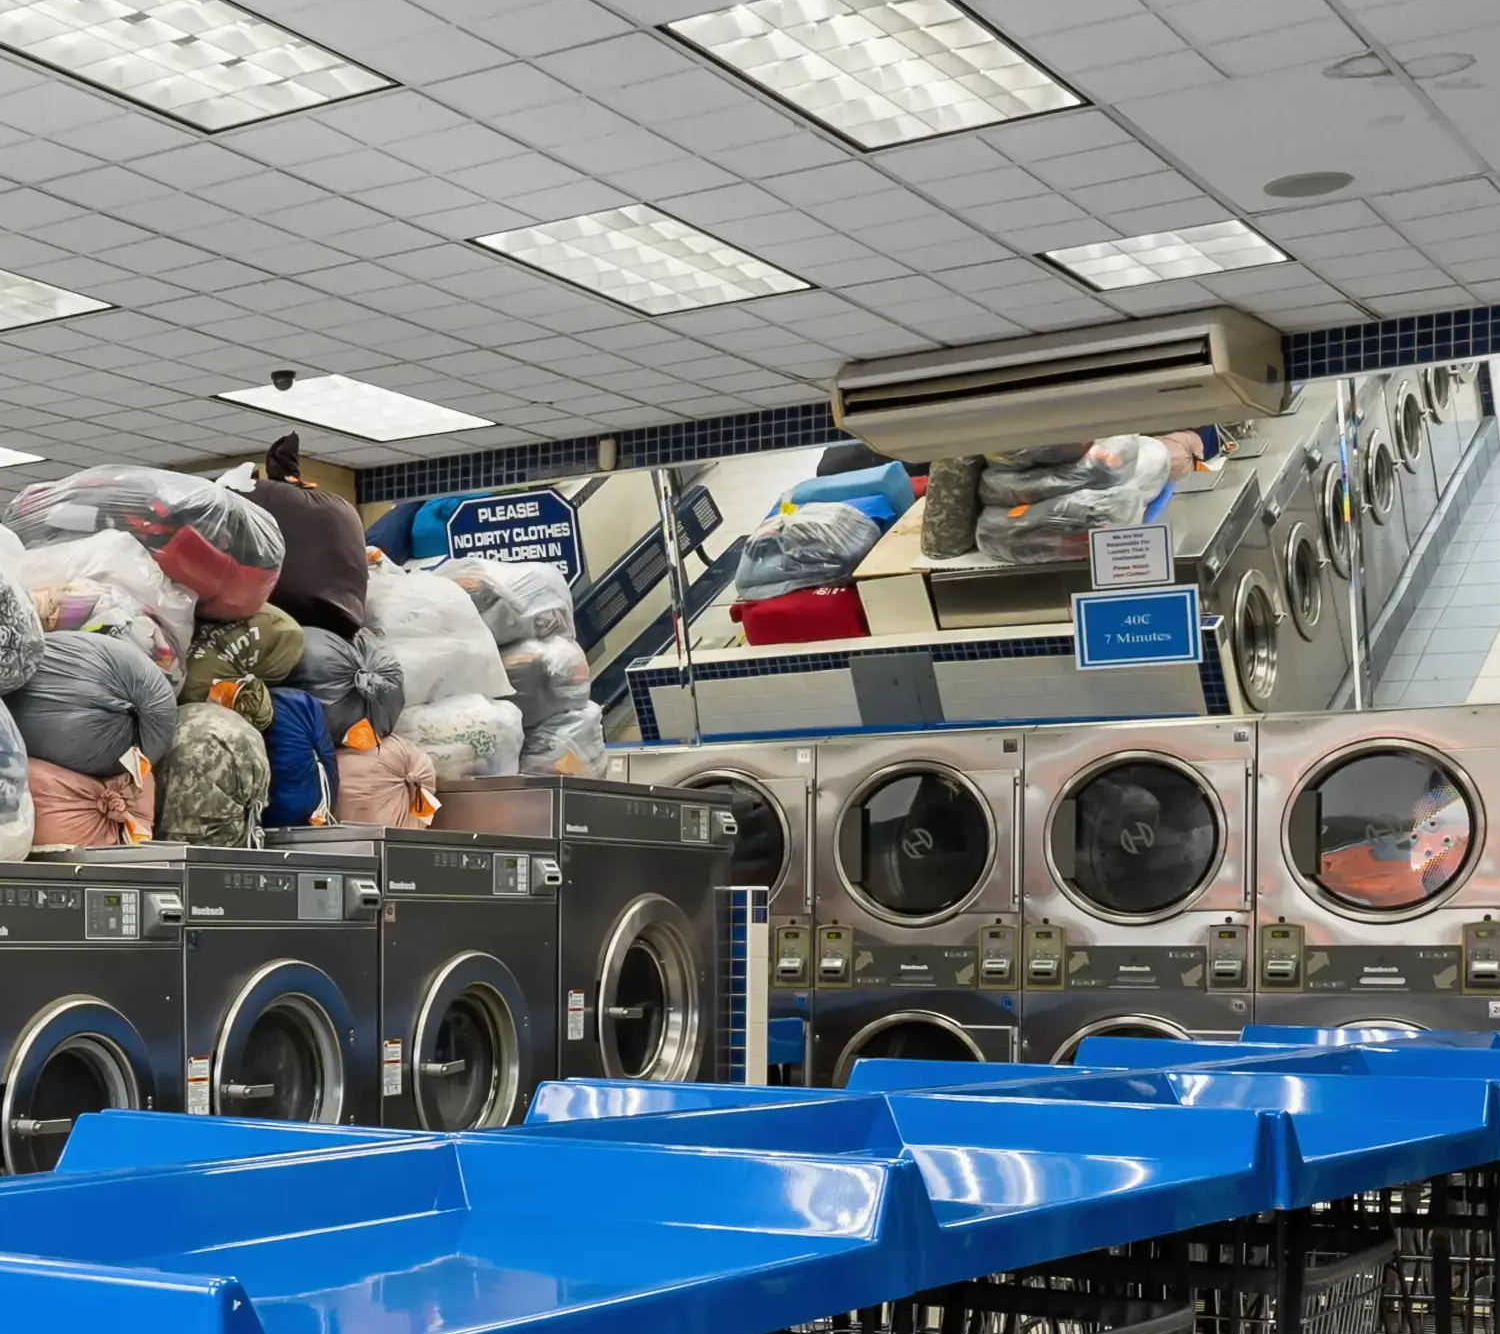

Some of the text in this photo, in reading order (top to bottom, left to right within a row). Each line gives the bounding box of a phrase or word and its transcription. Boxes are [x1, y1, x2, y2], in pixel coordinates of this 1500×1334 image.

[477, 501, 540, 523] PLEASE!
[454, 522, 571, 549] NO DIRTY CLOTHES
[486, 544, 546, 562] CHILDREN
[548, 542, 562, 557] IN
[1103, 631, 1172, 645] 7 Minutes
